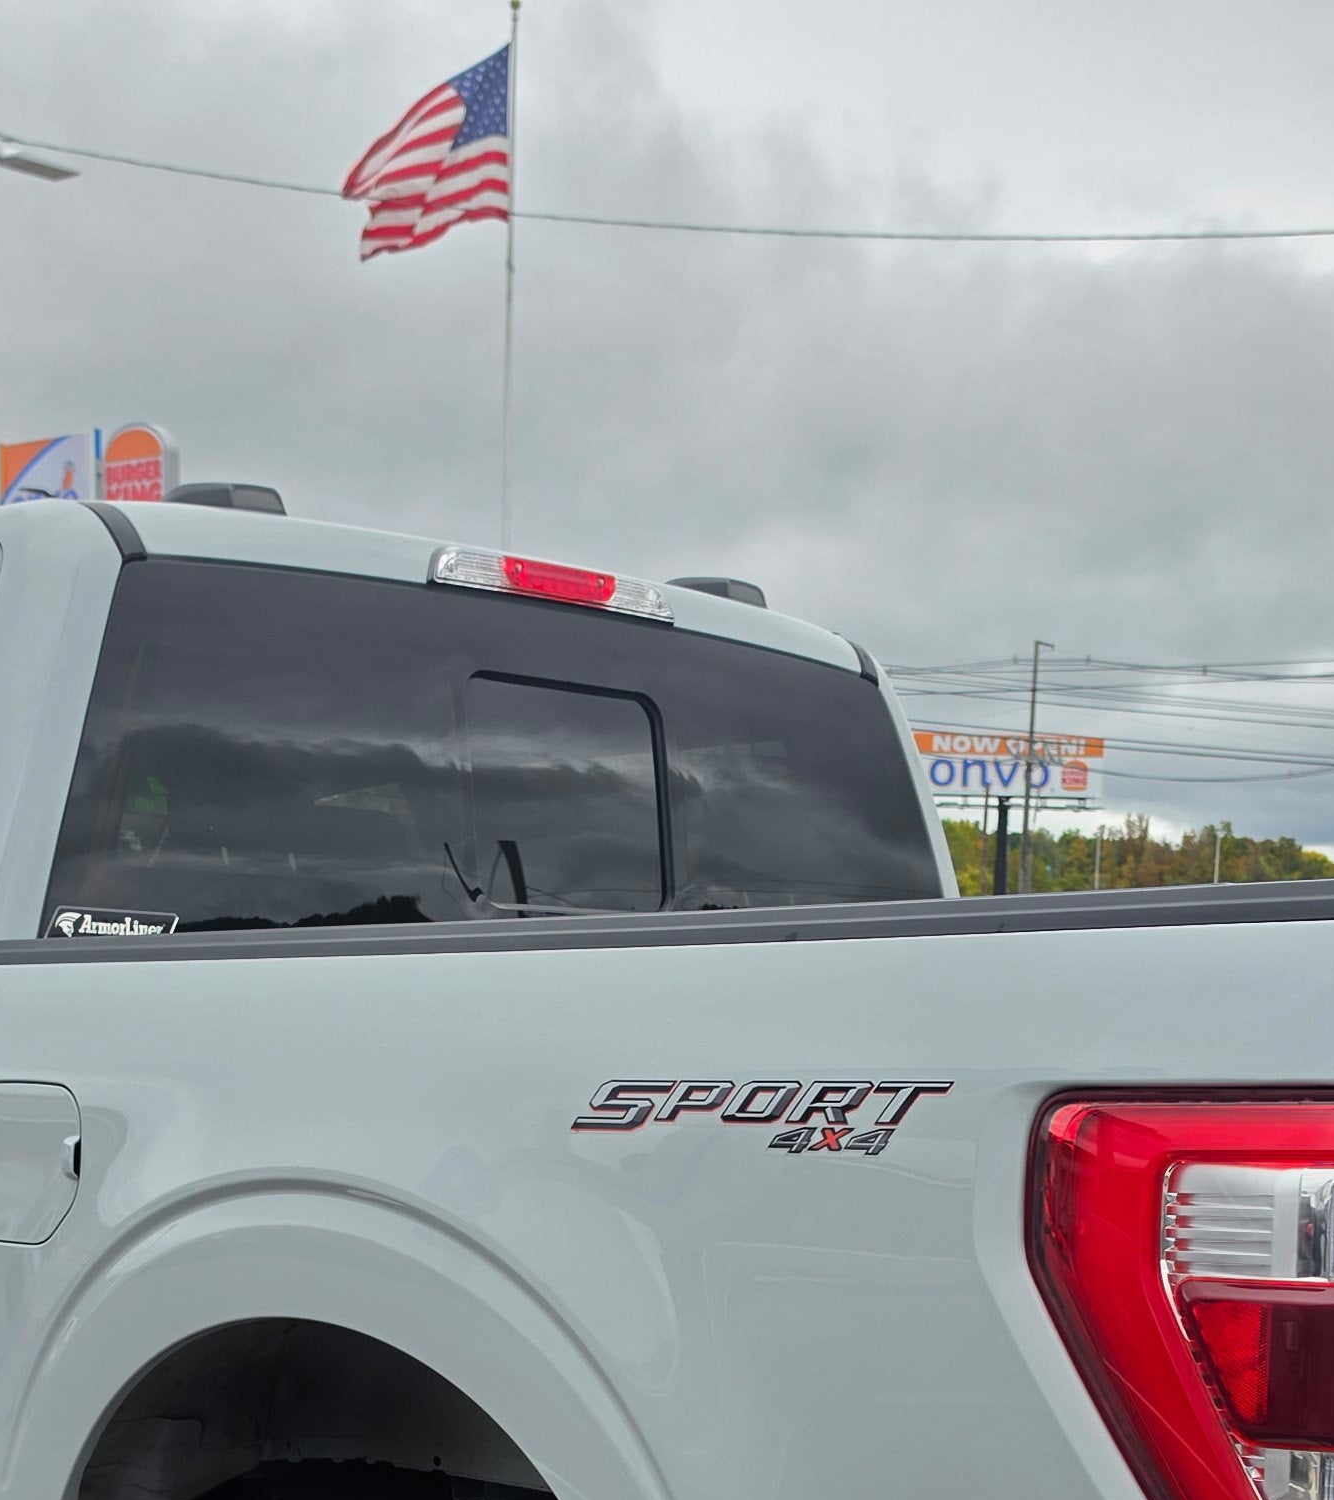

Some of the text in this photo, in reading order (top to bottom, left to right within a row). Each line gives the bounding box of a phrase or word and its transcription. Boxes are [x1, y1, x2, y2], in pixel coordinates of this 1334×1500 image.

[932, 735, 1001, 754] NOW
[929, 758, 1050, 790] onvo
[78, 913, 164, 936] ArmorLiner
[569, 1079, 956, 1133] SPORT
